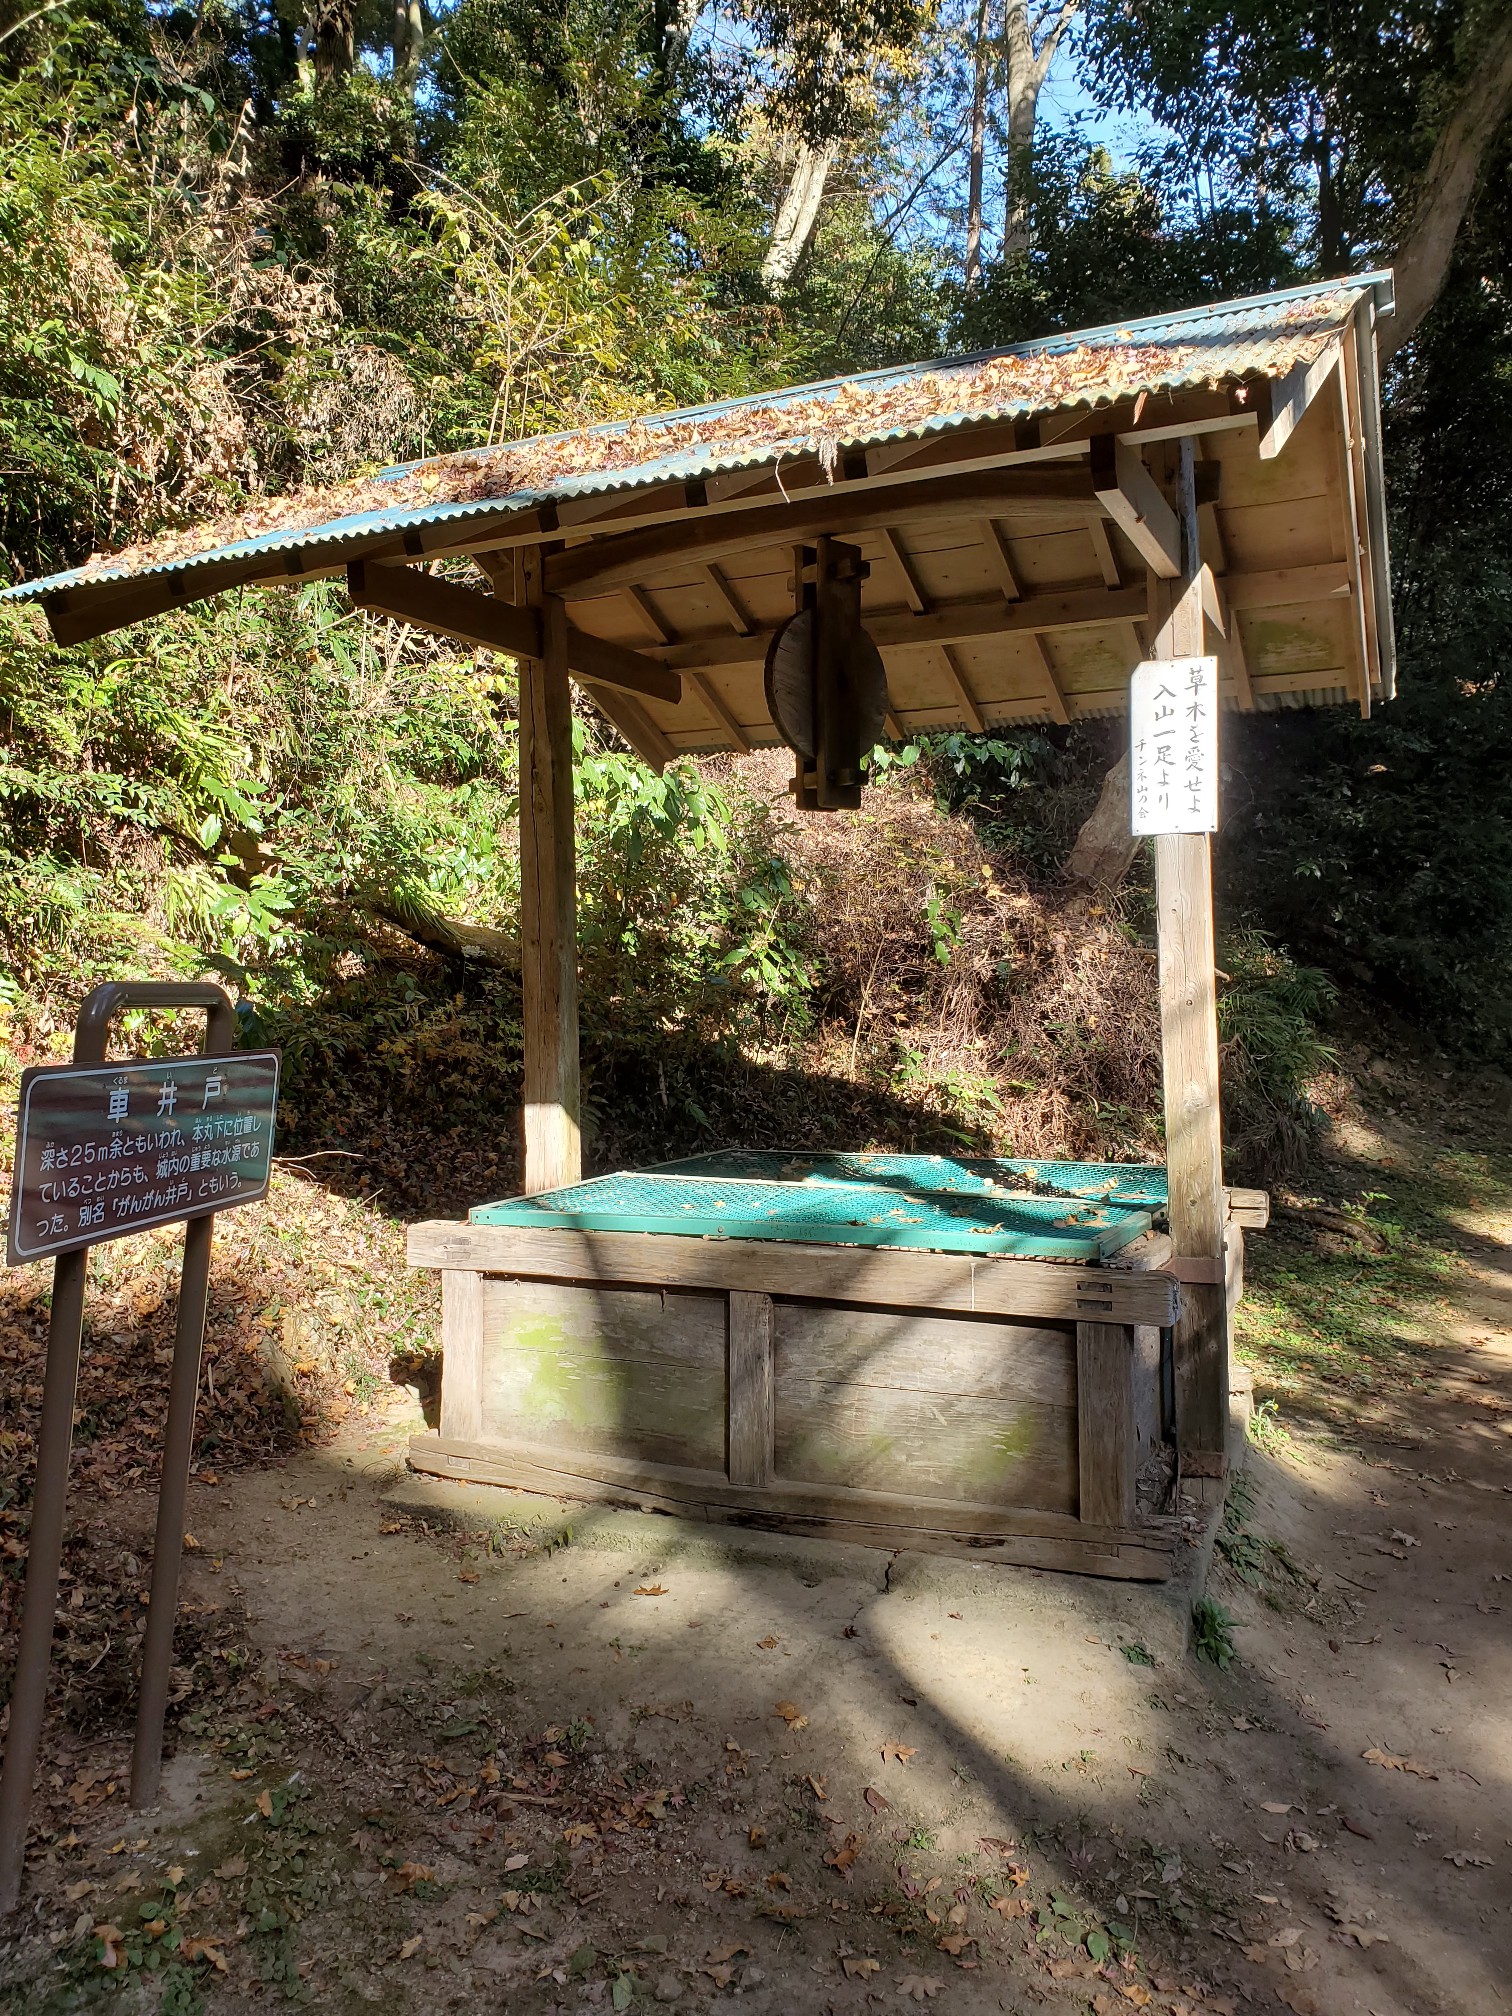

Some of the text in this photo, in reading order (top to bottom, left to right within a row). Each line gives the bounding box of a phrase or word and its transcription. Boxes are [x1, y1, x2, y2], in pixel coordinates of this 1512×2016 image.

[1152, 684, 1177, 810] 入山一足より
[1183, 665, 1207, 814] 草木を愛せよ
